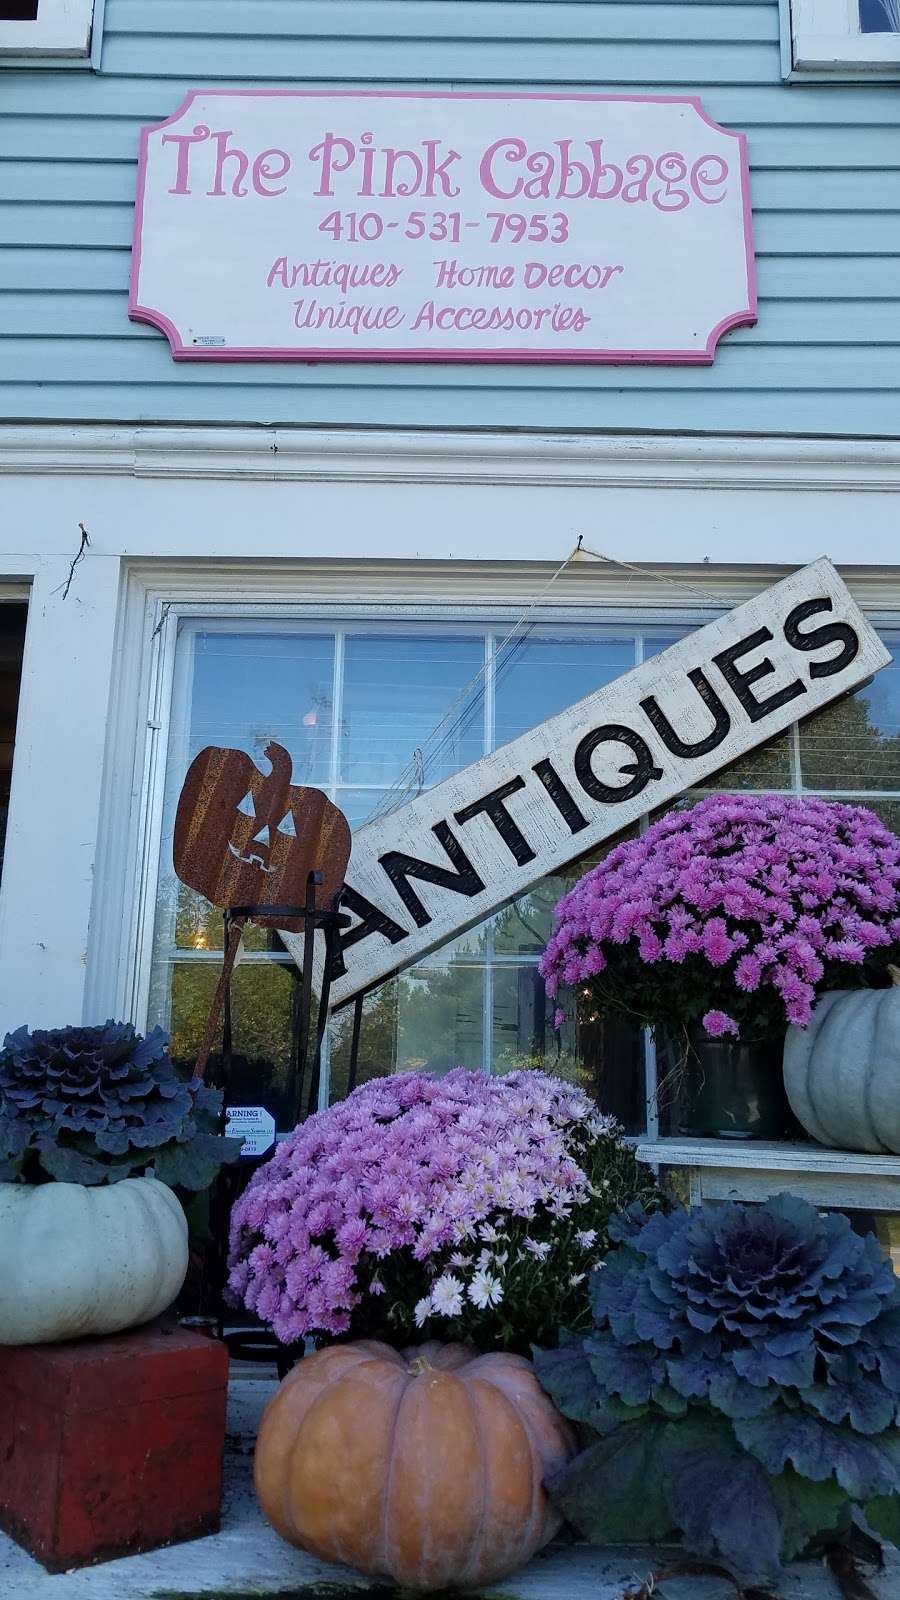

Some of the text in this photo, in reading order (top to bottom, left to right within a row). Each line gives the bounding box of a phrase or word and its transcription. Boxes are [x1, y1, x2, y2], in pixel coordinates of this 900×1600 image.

[162, 125, 729, 212] The Pink Cabbage
[318, 212, 569, 243] 410-531-7953
[267, 257, 623, 292] Antiques Home Decor
[294, 300, 591, 334] Unique Accessories
[327, 597, 860, 981] ANTIQUES
